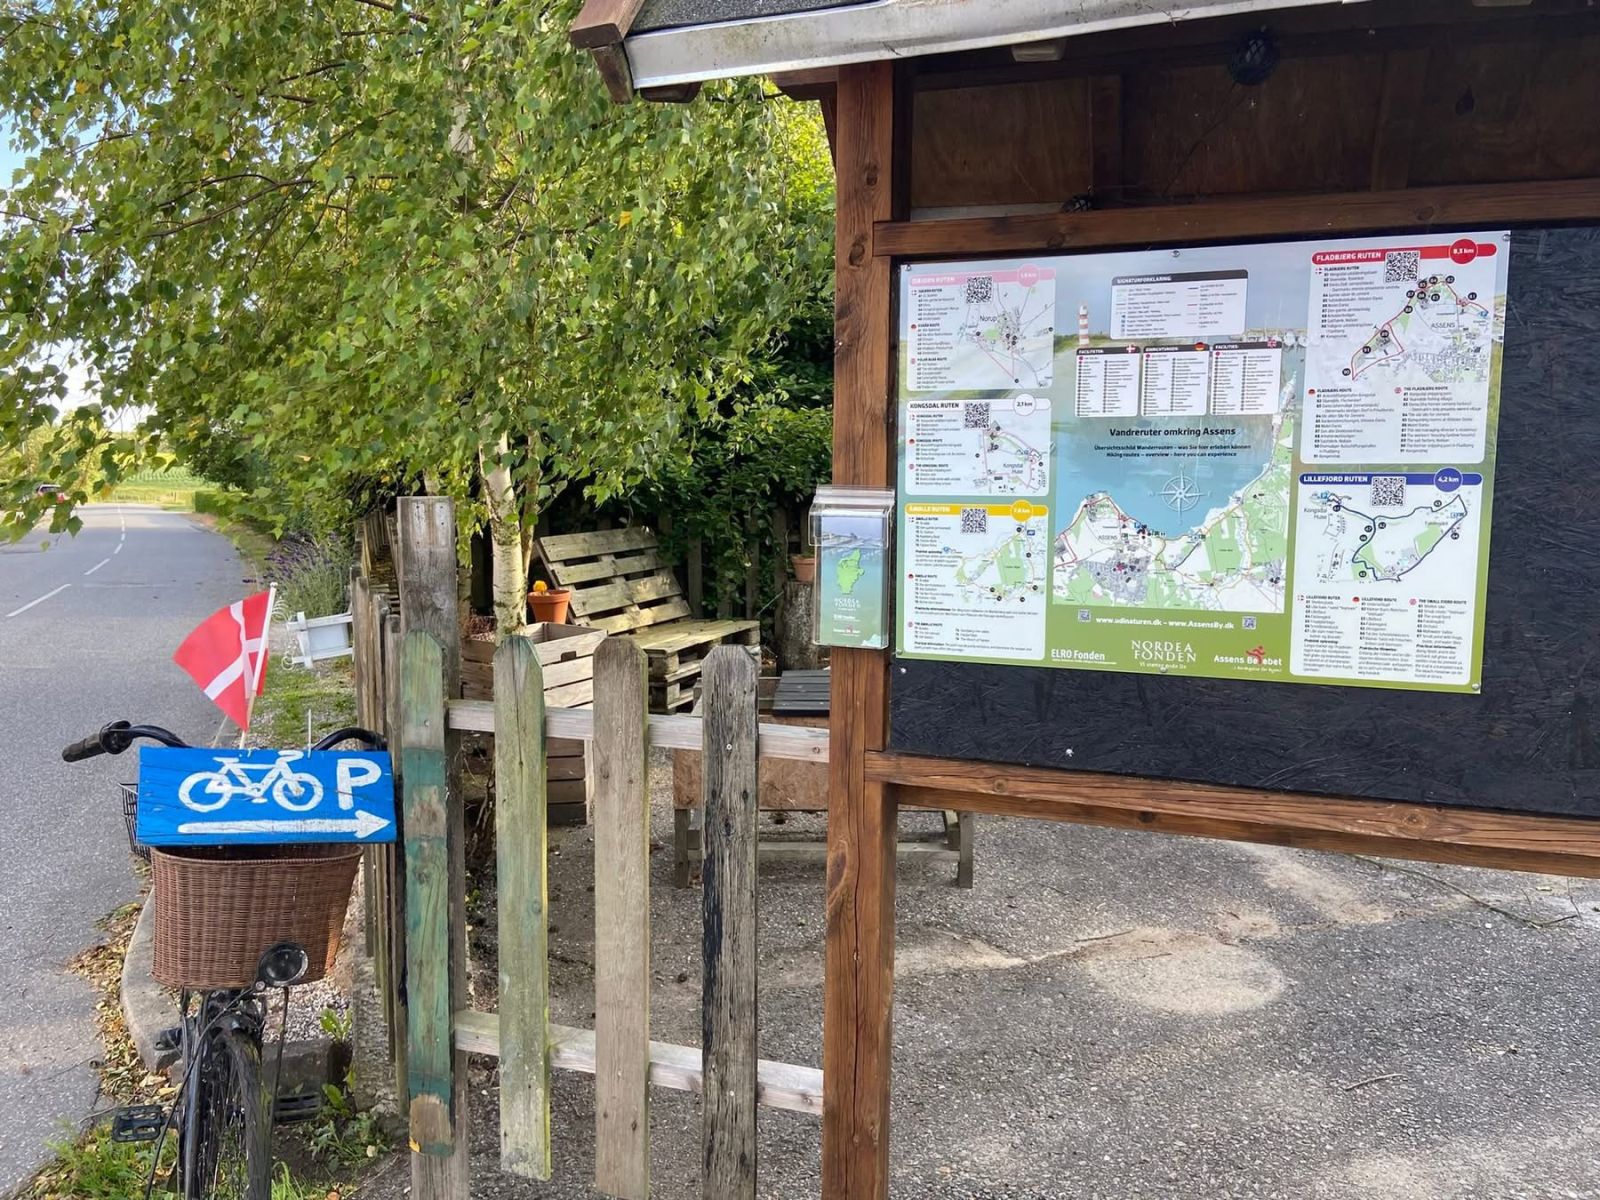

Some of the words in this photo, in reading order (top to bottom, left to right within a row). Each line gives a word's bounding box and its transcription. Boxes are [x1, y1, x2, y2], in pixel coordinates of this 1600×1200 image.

[1316, 253, 1356, 262] FLADBJERG
[1357, 251, 1382, 260] RUTEN
[980, 315, 998, 323] Norup
[1110, 428, 1162, 436] Vandreruter
[1163, 428, 1201, 438] omkring
[1202, 427, 1236, 436] Assens
[1096, 617, 1162, 626] www.udinaturen.dk
[1168, 620, 1234, 630] www.AssensBy.dk
[1131, 640, 1193, 653] NORDEA
[1051, 649, 1072, 659] ELRO
[1074, 650, 1106, 661] Fonden
[1134, 650, 1197, 663] FONDEN
[1214, 655, 1245, 664] Assens
[337, 758, 382, 810] P
